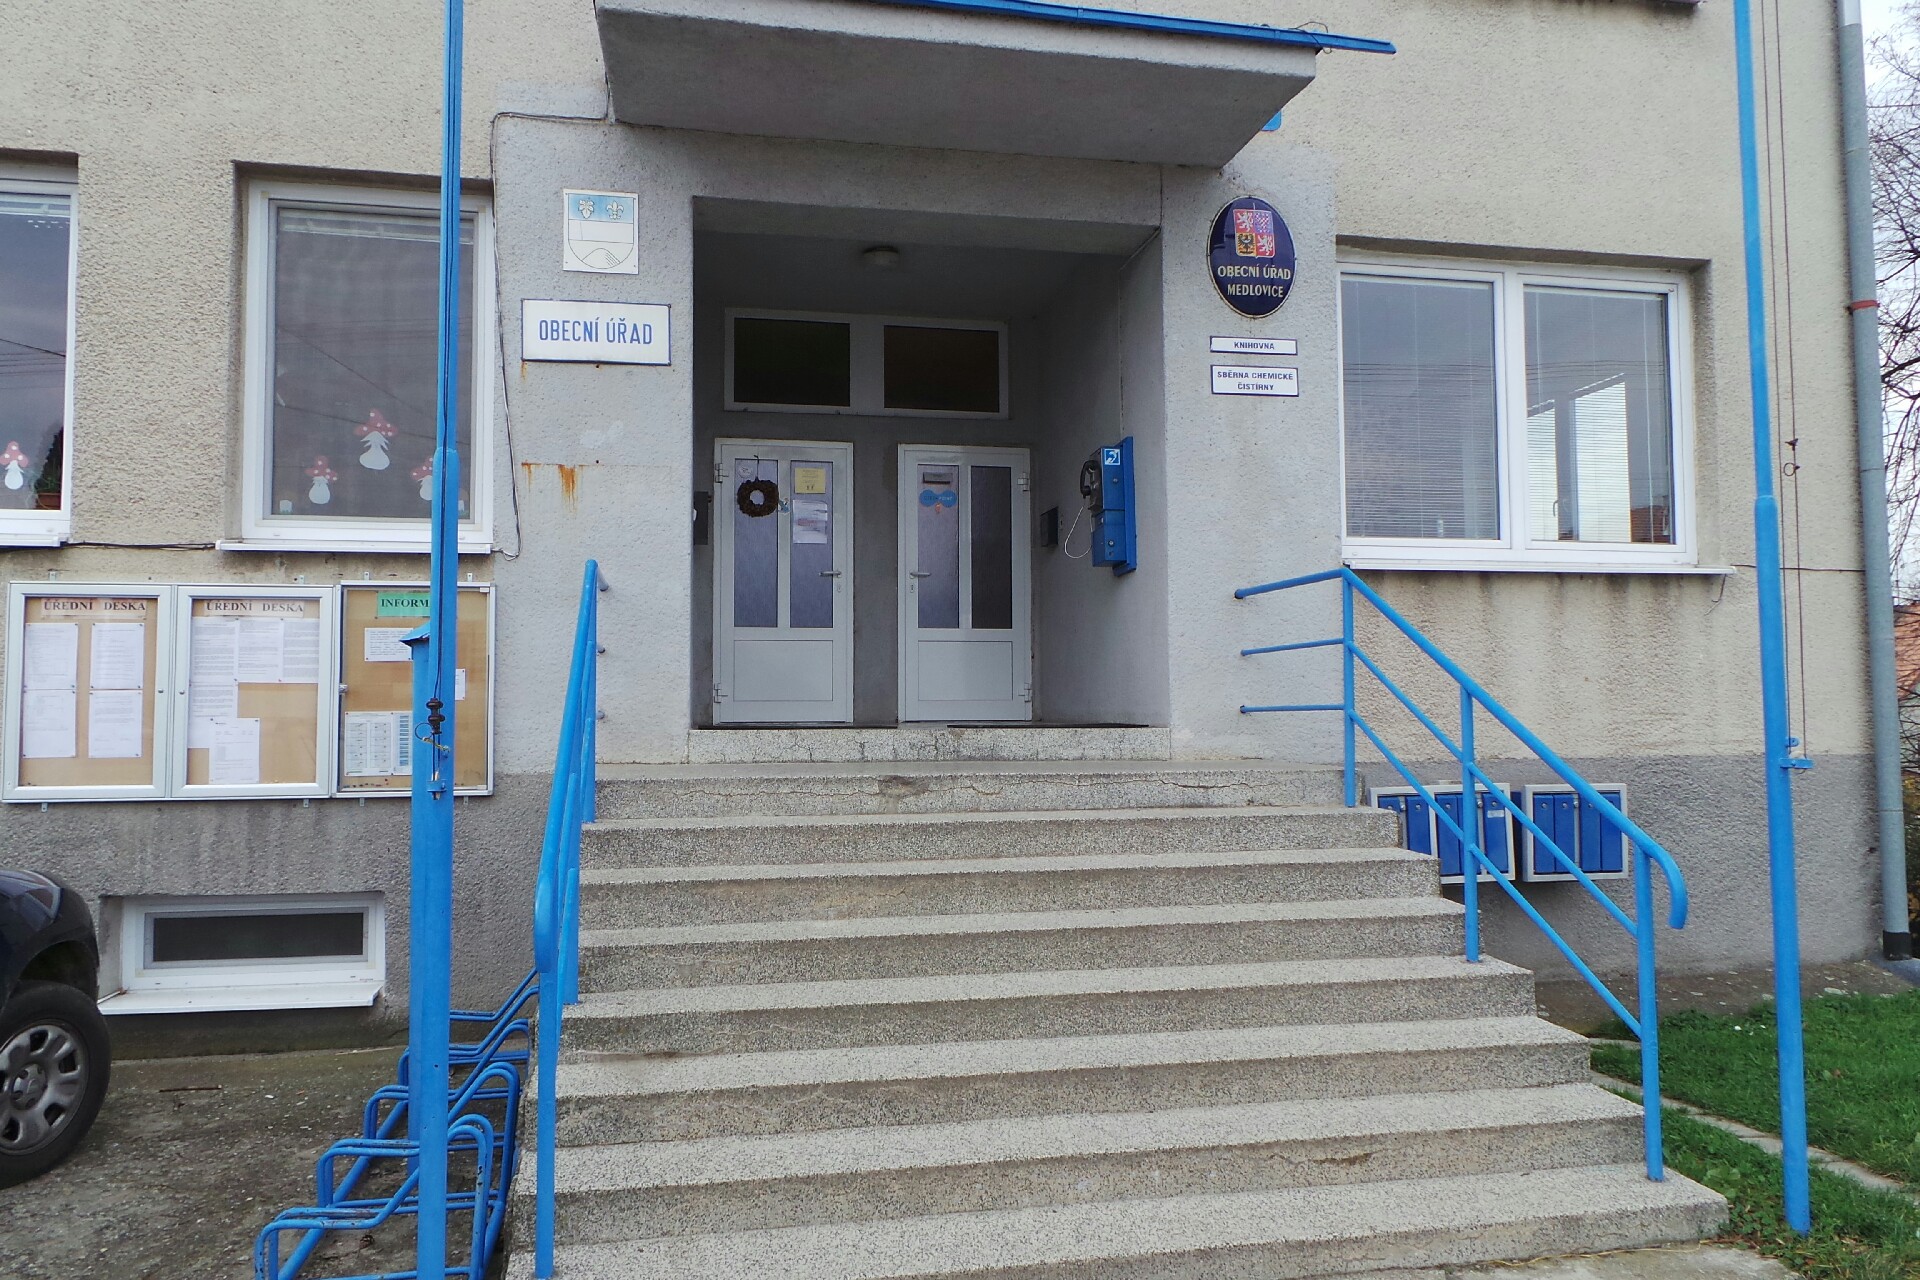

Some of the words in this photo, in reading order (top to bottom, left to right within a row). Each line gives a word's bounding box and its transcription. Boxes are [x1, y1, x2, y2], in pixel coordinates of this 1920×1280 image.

[1217, 263, 1260, 279] OBECNÍ
[1262, 264, 1292, 280] ÚŘAD
[1227, 283, 1284, 298] MEDLOVICE
[539, 316, 599, 343] OBECNÍ
[606, 317, 653, 345] ÚŘAD
[1233, 341, 1275, 350] KNIHOVNA
[1217, 369, 1249, 379] SBĚRNA
[1237, 381, 1274, 391] ČISTÍRNY
[44, 598, 93, 611] ÚŘEDNÍ
[104, 601, 146, 611] DESKA
[206, 599, 252, 611] ÚŘEDNÍ
[262, 602, 304, 612] DESKA
[381, 598, 430, 608] INFORM
